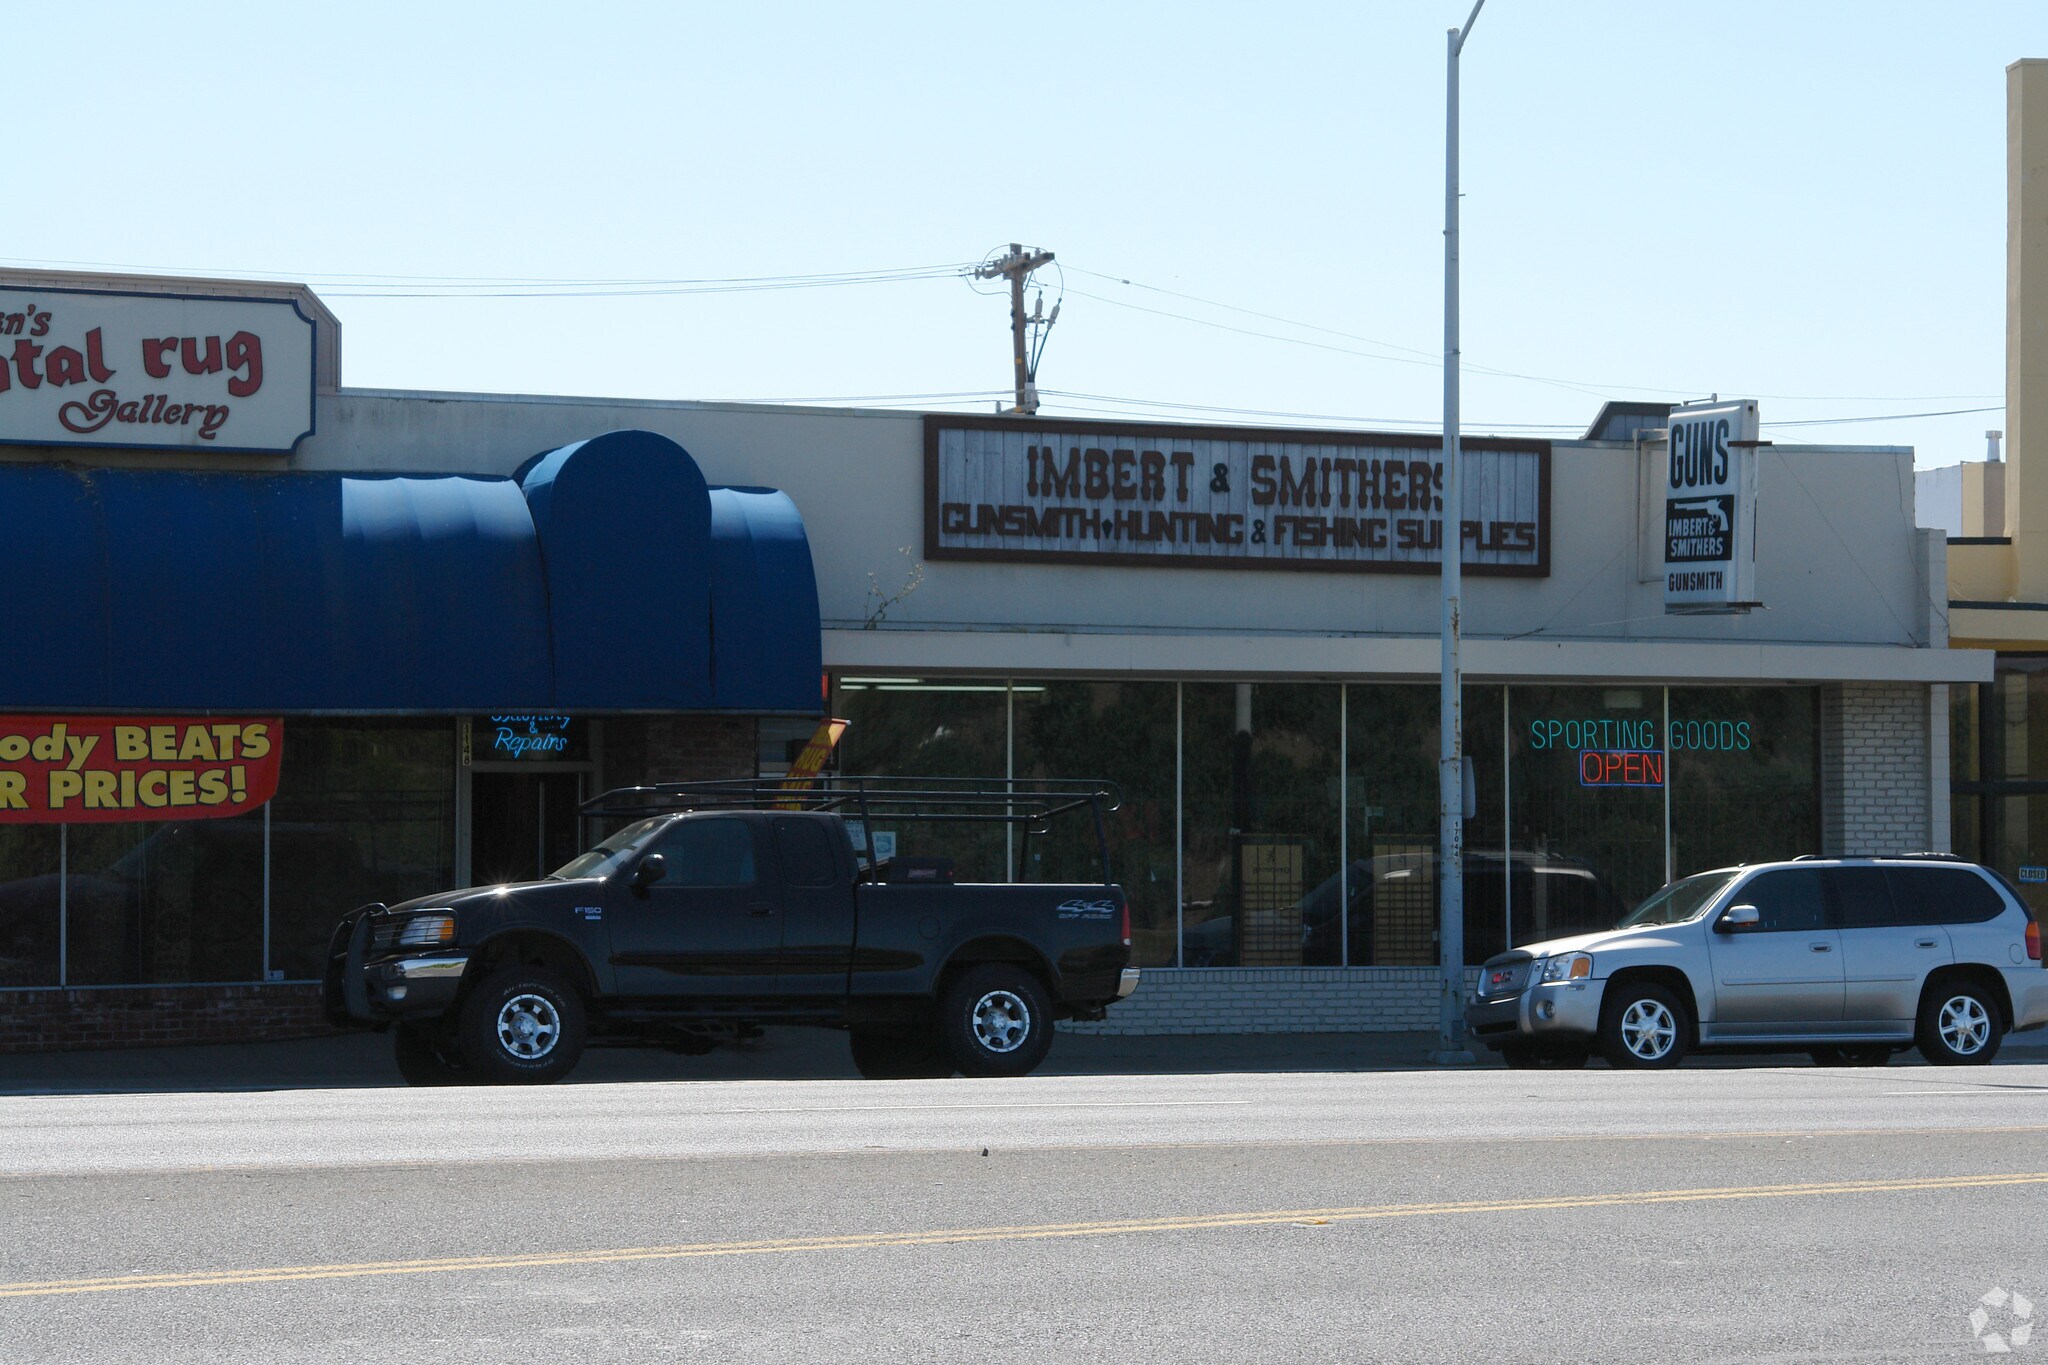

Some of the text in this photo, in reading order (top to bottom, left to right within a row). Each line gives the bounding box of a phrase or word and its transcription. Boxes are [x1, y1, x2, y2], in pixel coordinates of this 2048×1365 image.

[0, 304, 52, 336] n's
[142, 330, 263, 397] rug
[58, 388, 229, 440] Gallery
[1670, 419, 1729, 489] GUNS
[1027, 446, 1194, 501] IMBERT
[1210, 463, 1230, 493] &
[942, 503, 1536, 551] GUNSMITH HUNTING & FISHING SUPLIES
[1670, 537, 1724, 557] SMITHERS
[1668, 571, 1722, 592] GUNSMITH
[494, 726, 568, 759] Repairs
[529, 720, 539, 735] &
[1531, 720, 1750, 750] SPORTING GOODS
[0, 723, 272, 770] ody BEATS
[1582, 753, 1663, 783] OPEN
[49, 765, 248, 809] PRICES!
[2020, 868, 2046, 879] CLOSED
